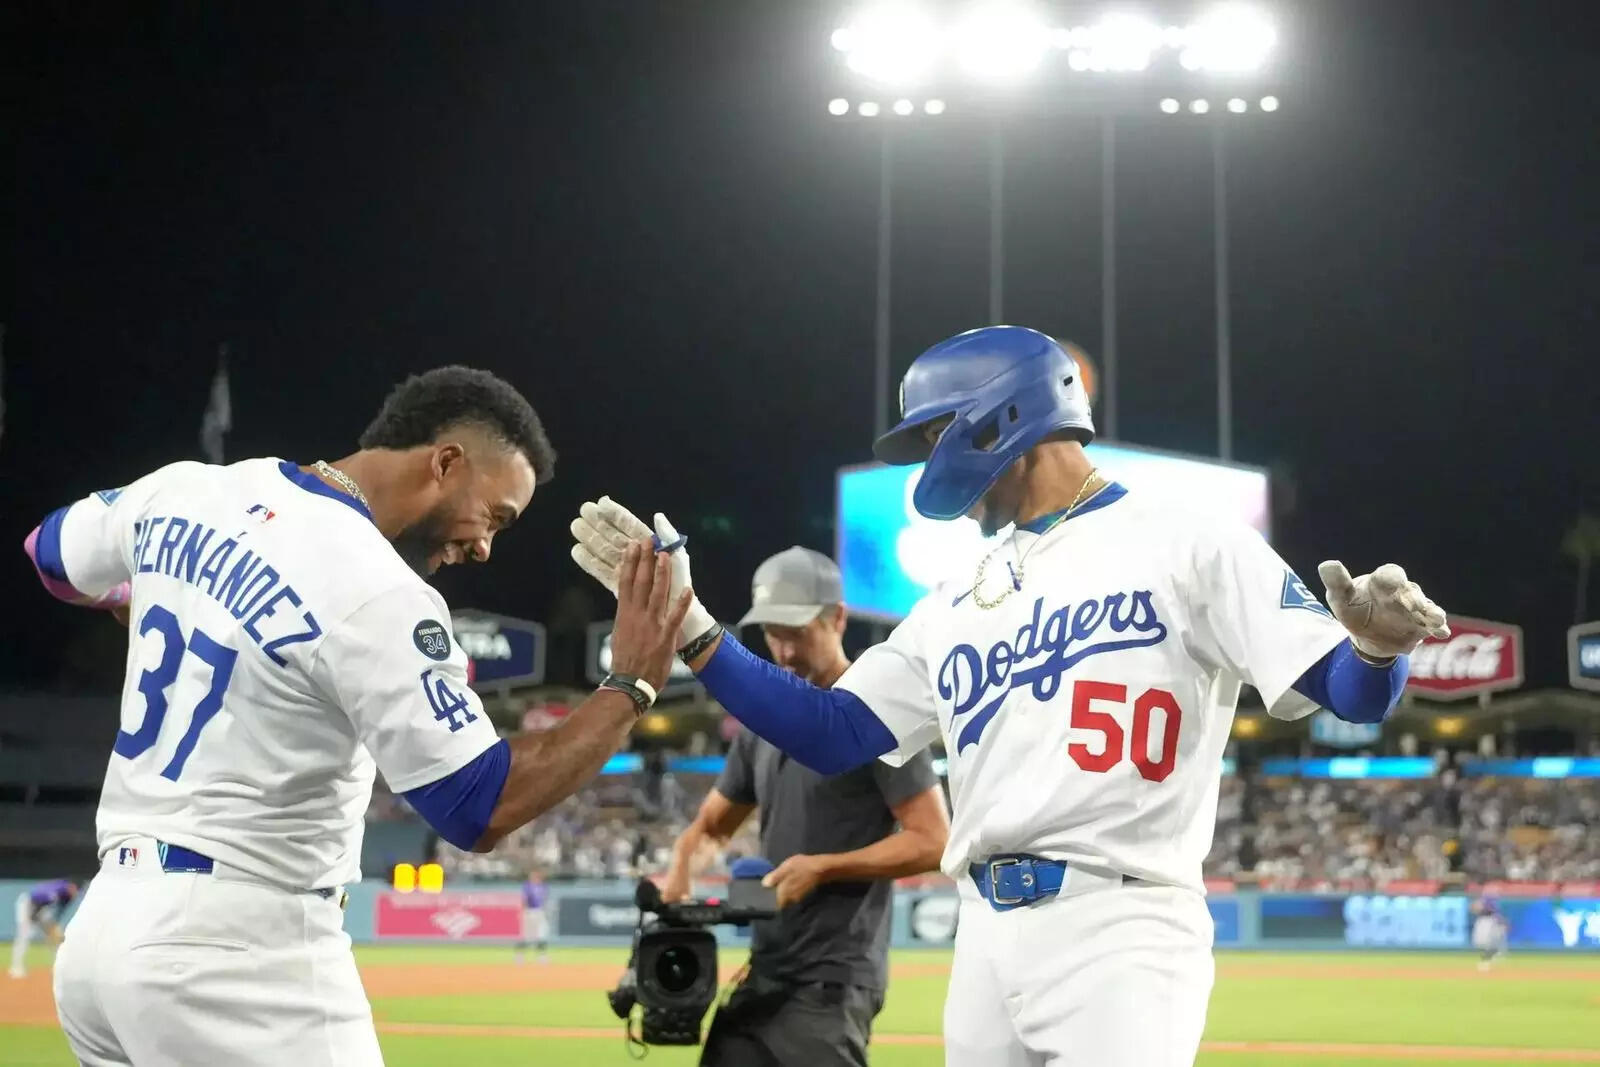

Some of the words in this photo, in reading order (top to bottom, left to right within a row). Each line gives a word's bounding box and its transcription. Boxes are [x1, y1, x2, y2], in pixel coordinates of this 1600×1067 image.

[133, 515, 322, 669] HERNÁNDEZ
[418, 626, 442, 636] FERNANDO
[423, 633, 448, 654] 34
[113, 604, 239, 783] 37
[420, 669, 478, 733] LA
[938, 590, 1167, 757] Dodgers
[1068, 680, 1182, 783] 50
